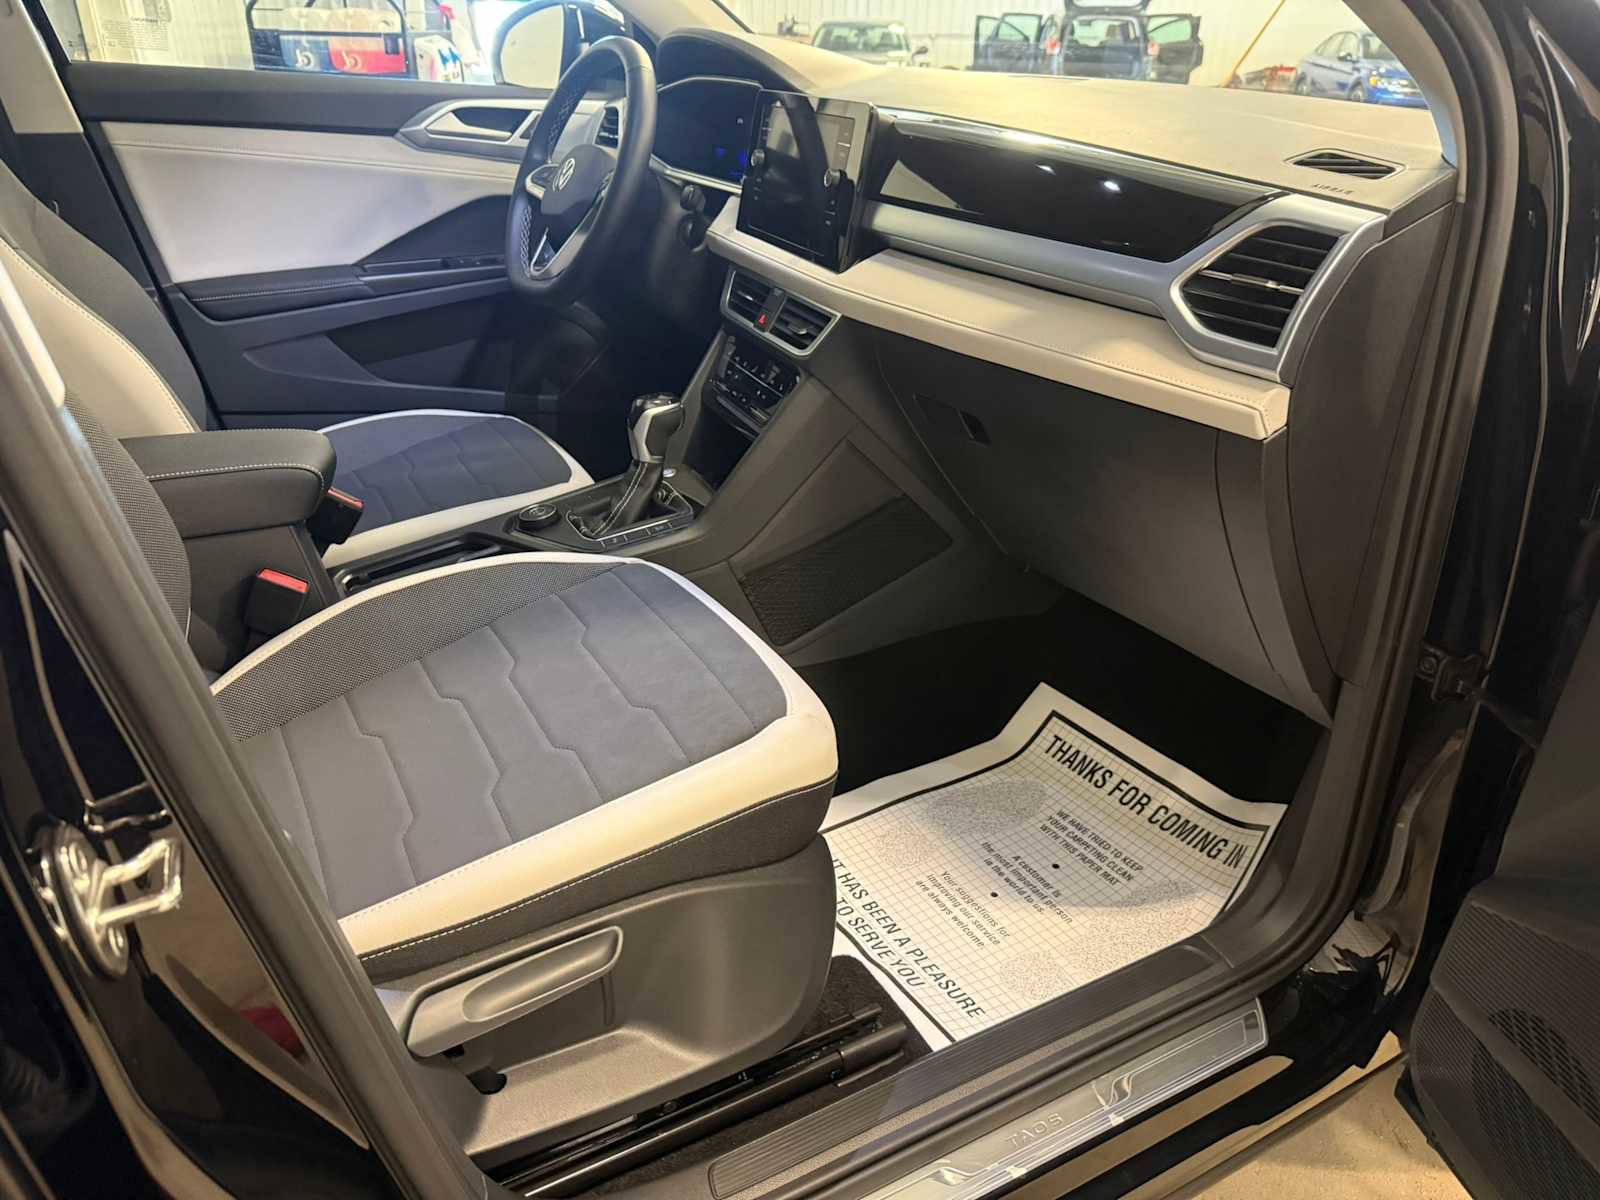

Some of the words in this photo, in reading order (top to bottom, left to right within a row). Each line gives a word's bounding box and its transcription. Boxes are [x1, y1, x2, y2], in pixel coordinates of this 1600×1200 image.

[1045, 735, 1114, 789] THANKS
[1107, 779, 1152, 815] FOR
[1148, 805, 1229, 860] COMING
[1223, 843, 1249, 869] IN
[1040, 824, 1061, 841] WITH
[1059, 839, 1078, 854] THIS
[1075, 852, 1103, 873] PAPER
[1100, 871, 1121, 886] MAT
[1048, 815, 1069, 833] YOUR
[1065, 830, 1109, 863] CARPETING
[1106, 861, 1135, 881] CLEAN
[1057, 809, 1071, 820] WE
[1068, 818, 1090, 835] HAVE
[1087, 832, 1112, 850] TRIED
[1110, 848, 1123, 858] TO
[1120, 855, 1144, 871] KEEP
[915, 880, 930, 892] are
[927, 891, 953, 916] always
[927, 873, 961, 908] improving
[960, 907, 974, 919] our
[972, 919, 1001, 945] service
[941, 871, 958, 887] Your
[955, 887, 999, 927] suggestions
[997, 926, 1011, 937] for
[982, 842, 995, 854] the
[993, 853, 1014, 869] most
[1010, 868, 1049, 901] important
[1044, 900, 1073, 924] person
[984, 858, 993, 866] in
[991, 865, 1005, 877] the
[1004, 877, 1028, 896] world
[1024, 895, 1034, 904] to
[1018, 861, 1054, 891] customer
[1052, 889, 1062, 898] is
[837, 897, 854, 917] TO
[848, 917, 896, 960] SERVE
[890, 958, 925, 987] YOU
[838, 872, 869, 900] HAS
[862, 900, 901, 935] BEEN
[894, 936, 911, 948] A
[907, 947, 987, 1018] PLEASURE
